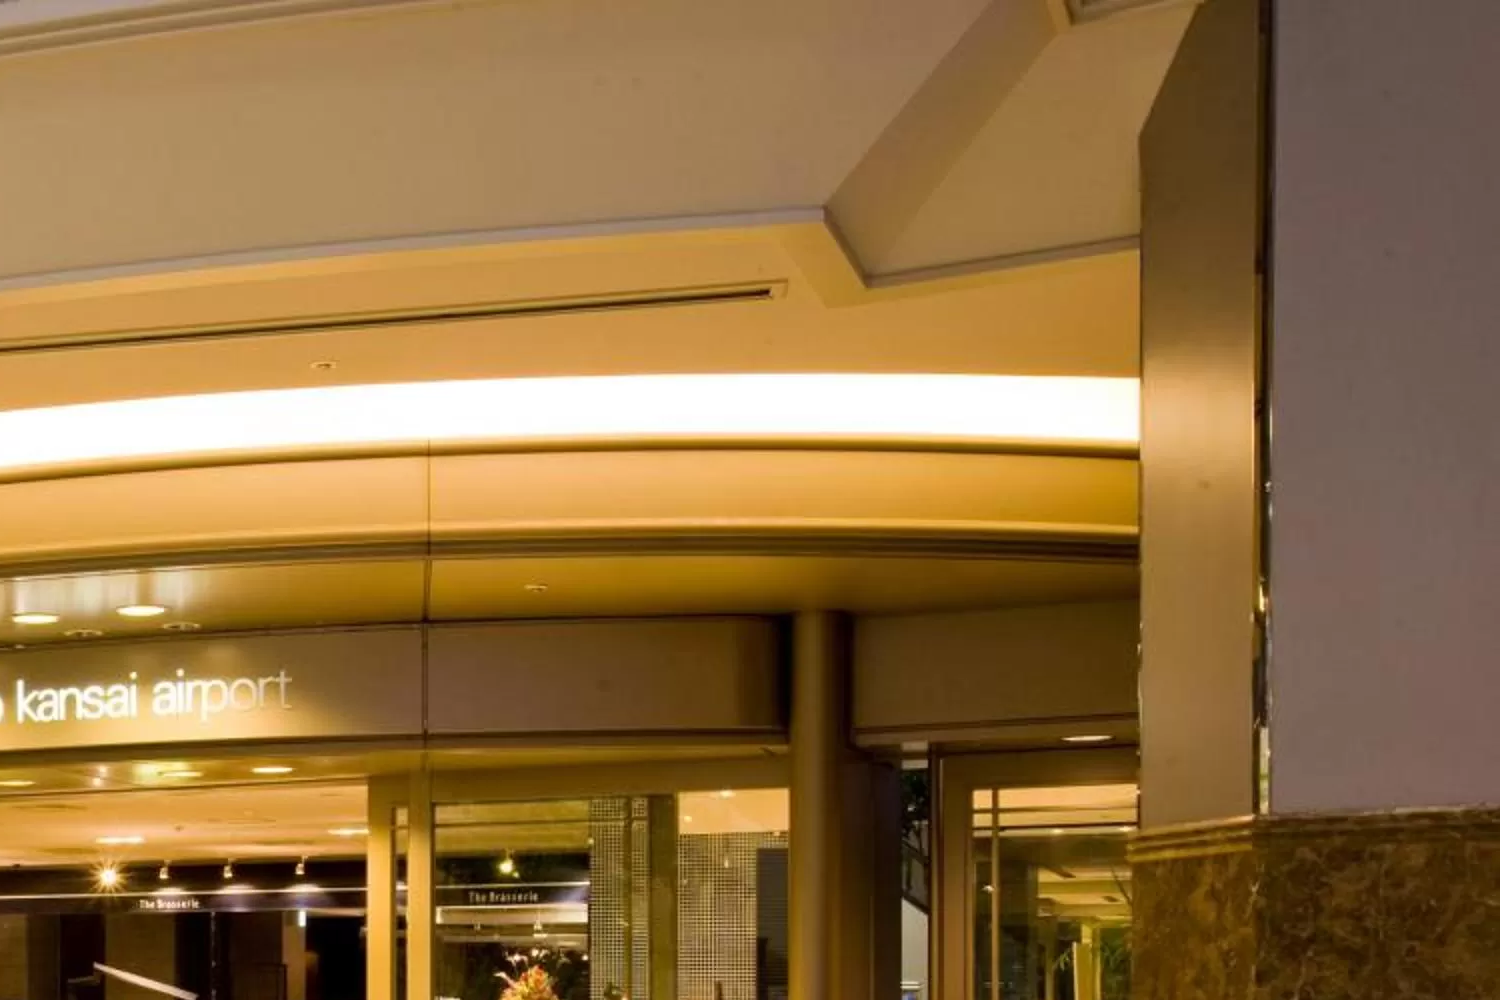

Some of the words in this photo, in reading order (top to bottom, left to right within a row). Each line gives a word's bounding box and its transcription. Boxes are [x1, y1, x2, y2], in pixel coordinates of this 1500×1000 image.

[16, 671, 138, 725] kansai
[152, 668, 293, 721] airport
[468, 891, 487, 902] The
[489, 890, 539, 902] Brasserie
[139, 899, 155, 909] The
[157, 898, 200, 909] Brasserie
